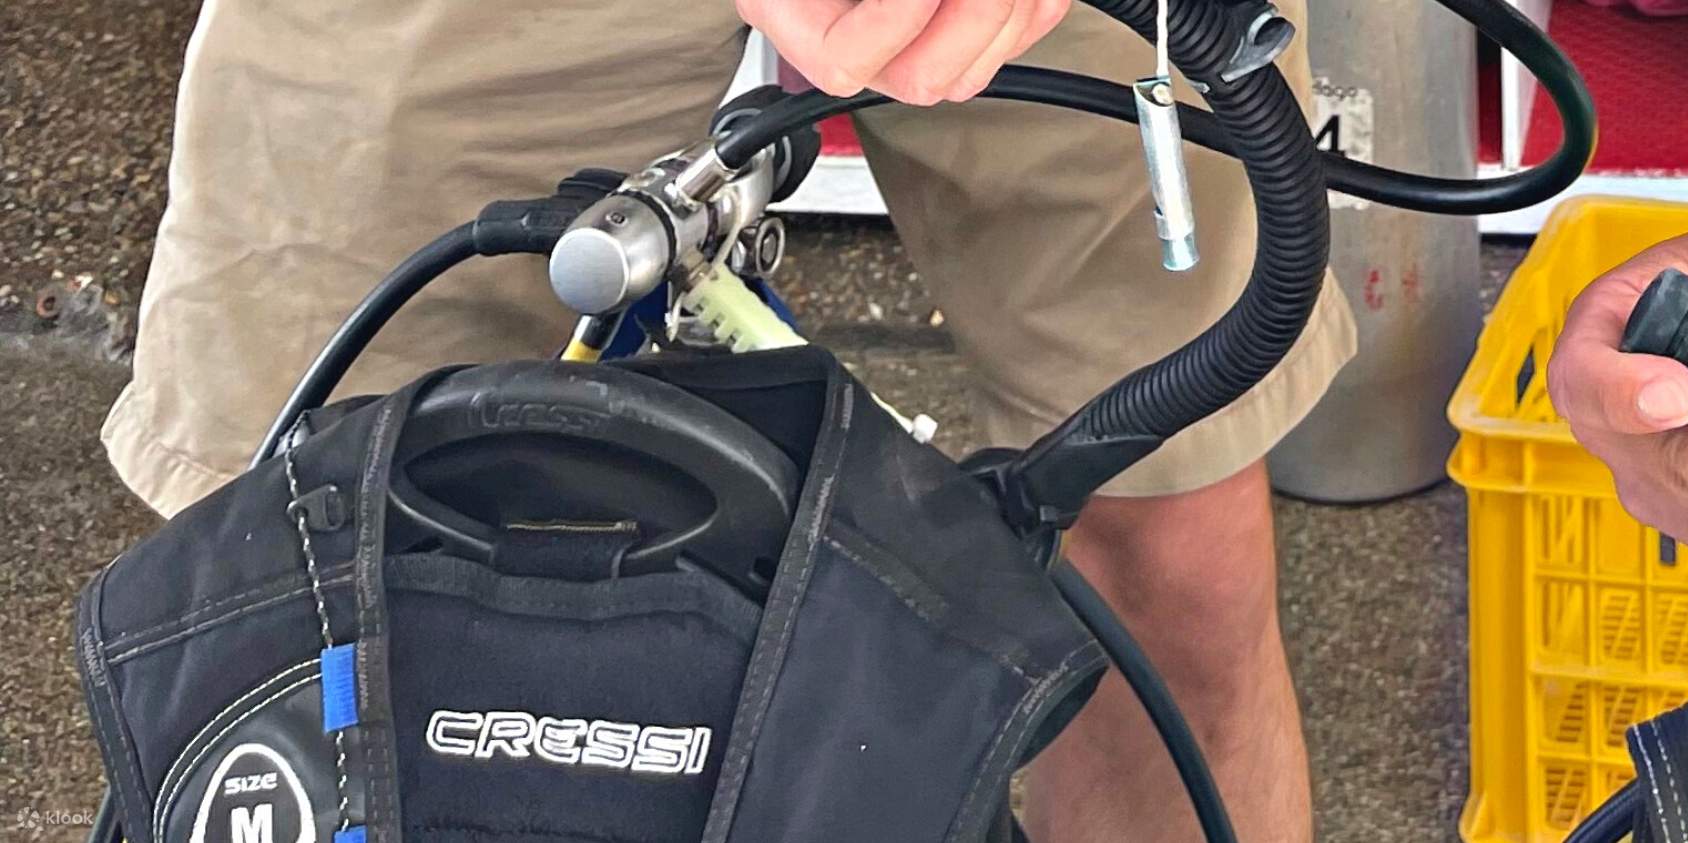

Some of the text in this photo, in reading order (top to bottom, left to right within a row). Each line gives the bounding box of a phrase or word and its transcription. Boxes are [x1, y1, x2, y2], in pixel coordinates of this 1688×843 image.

[426, 710, 712, 774] CRESSI
[224, 772, 278, 796] SIZE
[230, 803, 274, 843] M
